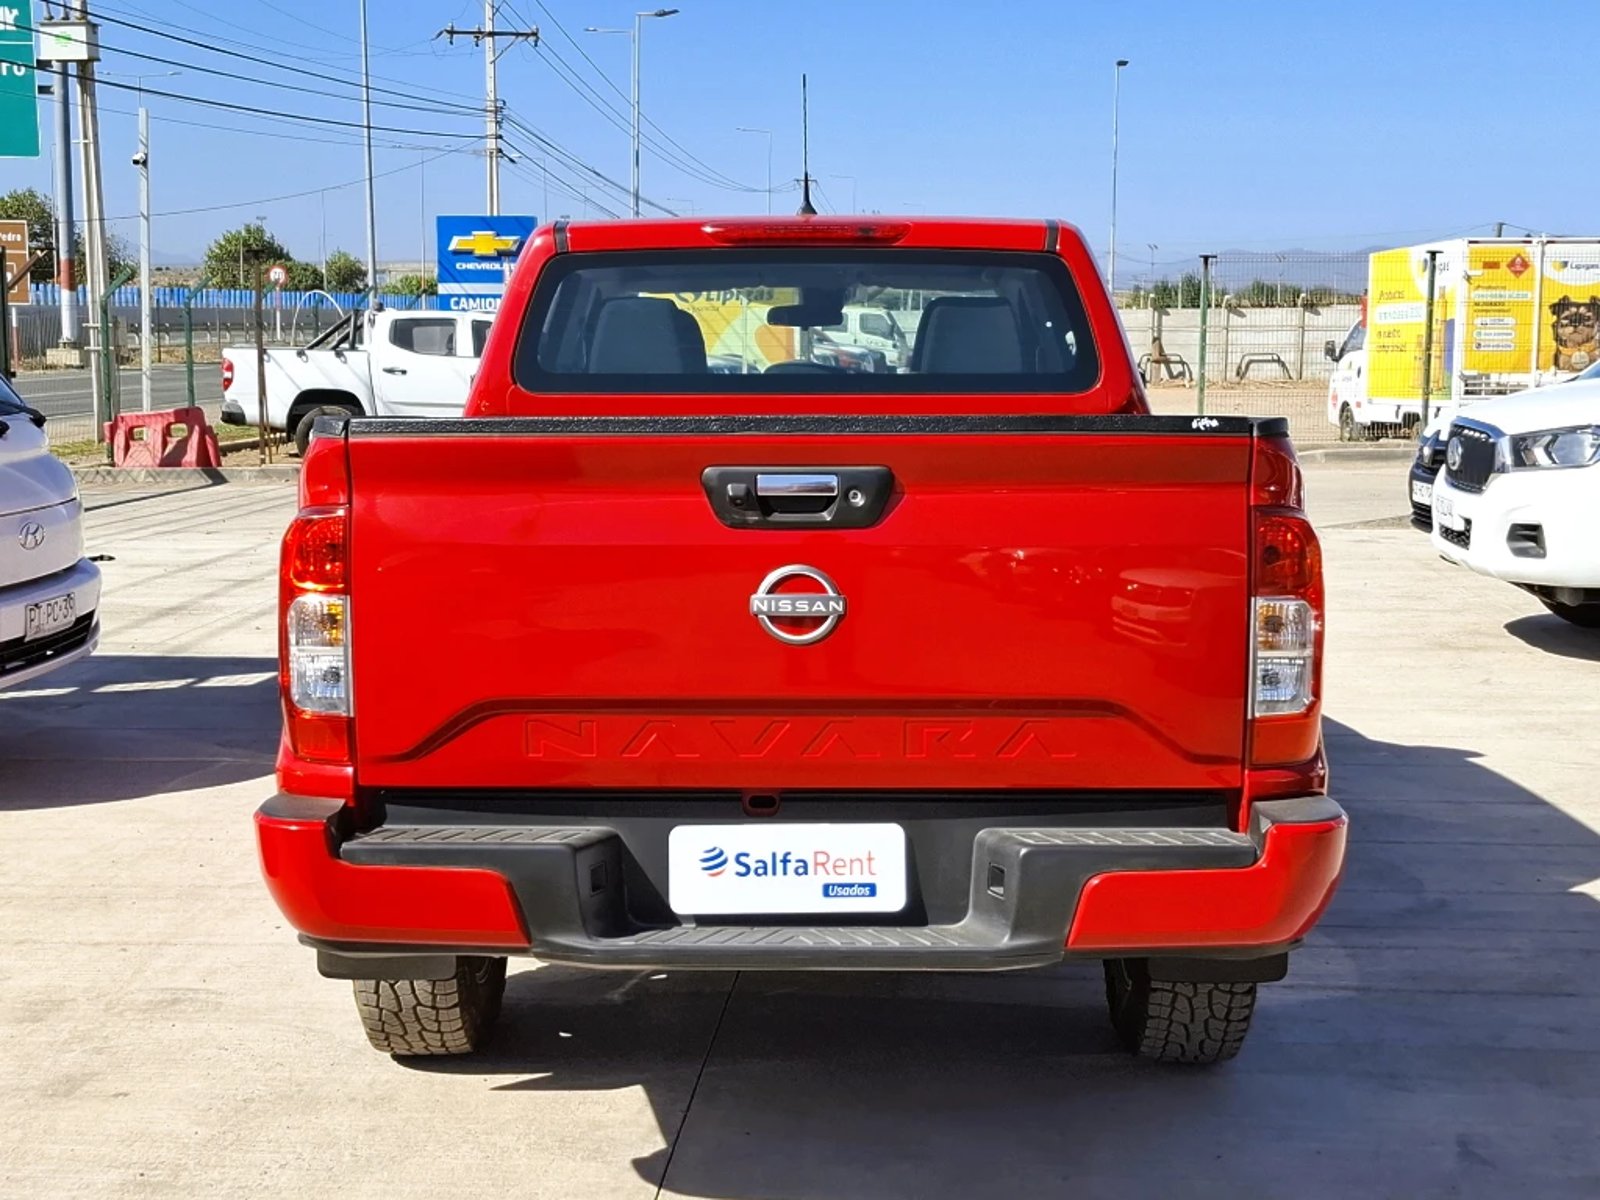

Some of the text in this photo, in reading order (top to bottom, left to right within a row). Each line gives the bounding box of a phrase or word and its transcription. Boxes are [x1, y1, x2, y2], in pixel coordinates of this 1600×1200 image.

[753, 600, 843, 612] NISSAN
[524, 718, 1078, 758] NAVARA
[828, 884, 870, 897] Usados
